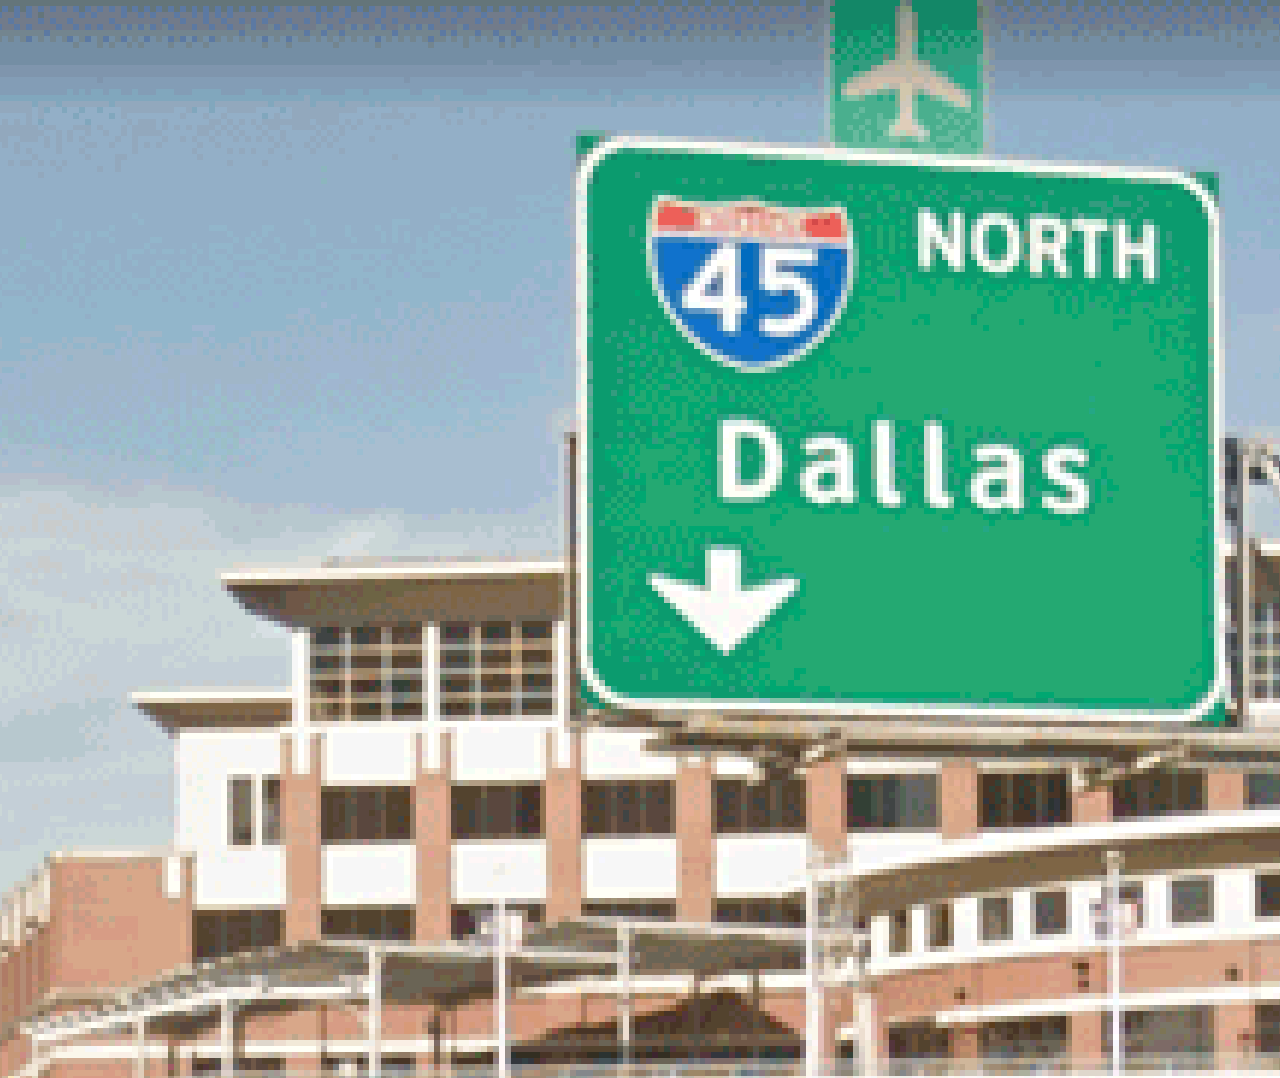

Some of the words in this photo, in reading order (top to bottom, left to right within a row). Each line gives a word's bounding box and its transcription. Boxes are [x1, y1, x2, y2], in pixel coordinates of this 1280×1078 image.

[681, 243, 819, 335] 45
[917, 207, 1158, 283] NORTH
[718, 417, 1093, 514] Dallas
